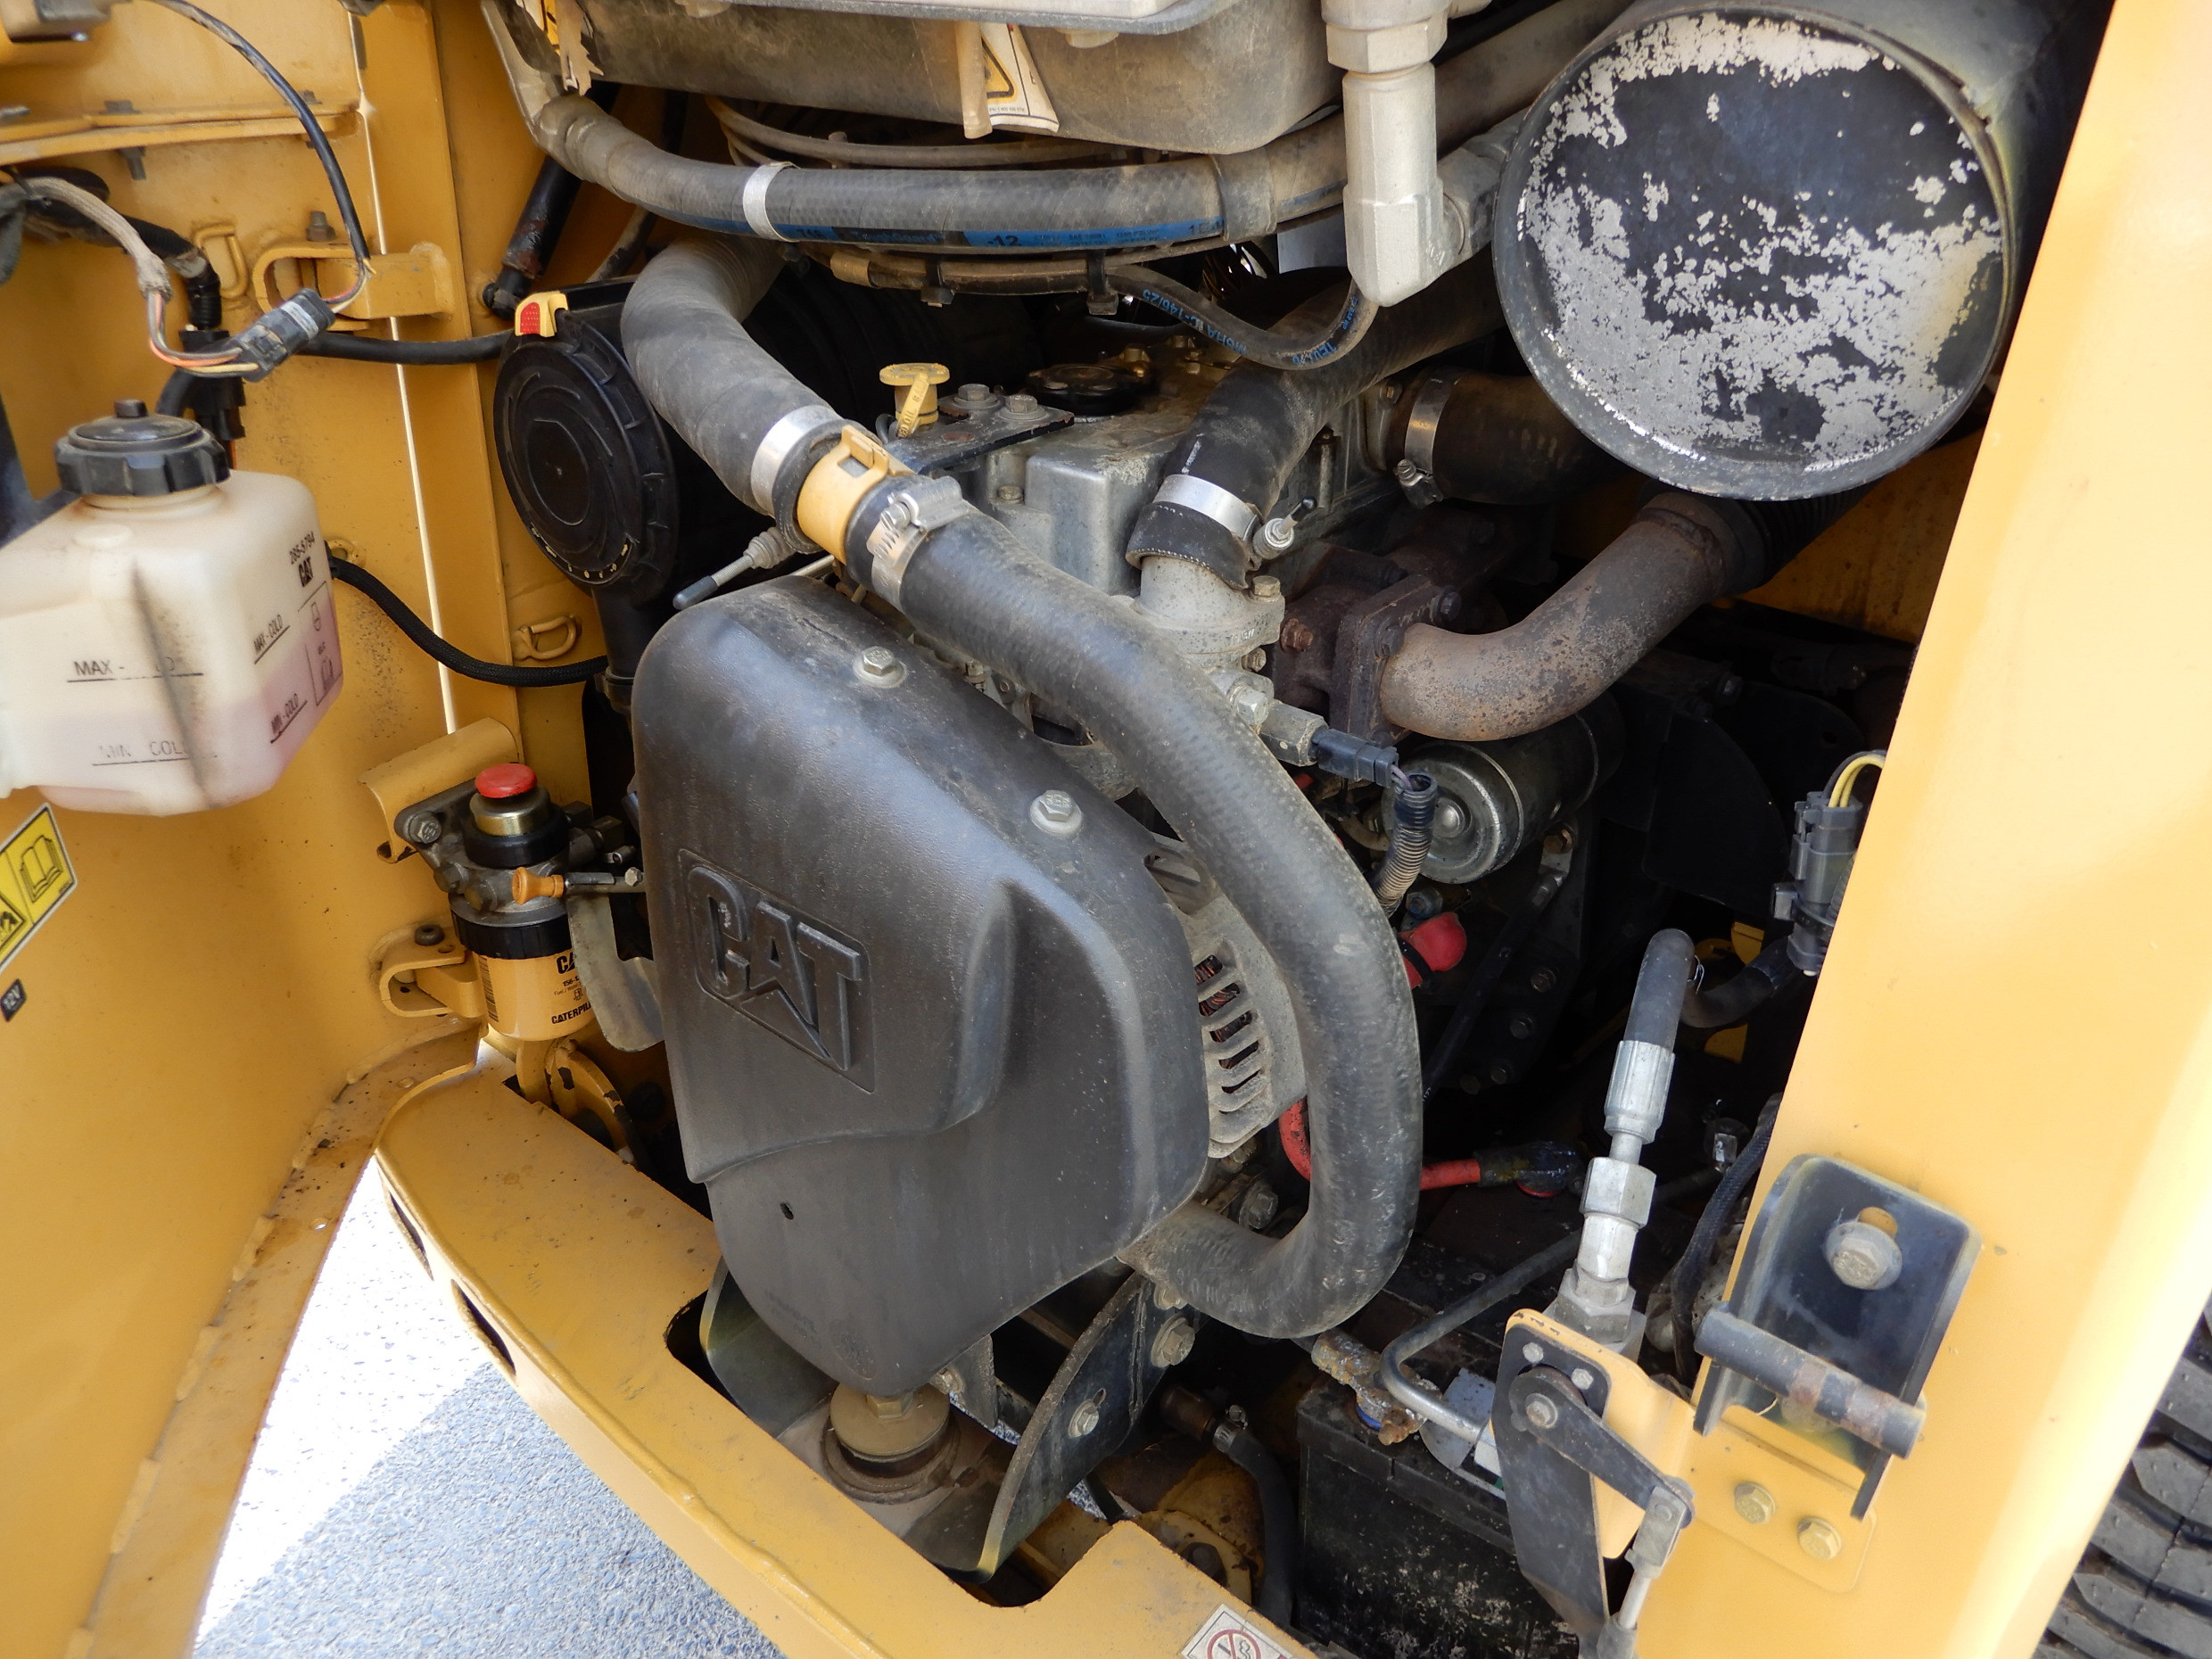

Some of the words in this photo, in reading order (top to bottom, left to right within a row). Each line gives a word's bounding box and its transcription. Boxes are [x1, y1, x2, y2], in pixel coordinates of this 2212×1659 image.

[986, 235, 1022, 247] -12
[298, 557, 314, 587] CAT
[73, 659, 113, 676] MAX
[149, 740, 186, 756] COL
[557, 952, 575, 974] CA
[687, 865, 862, 1071] CAT
[551, 1001, 591, 1024] CATERPIL
